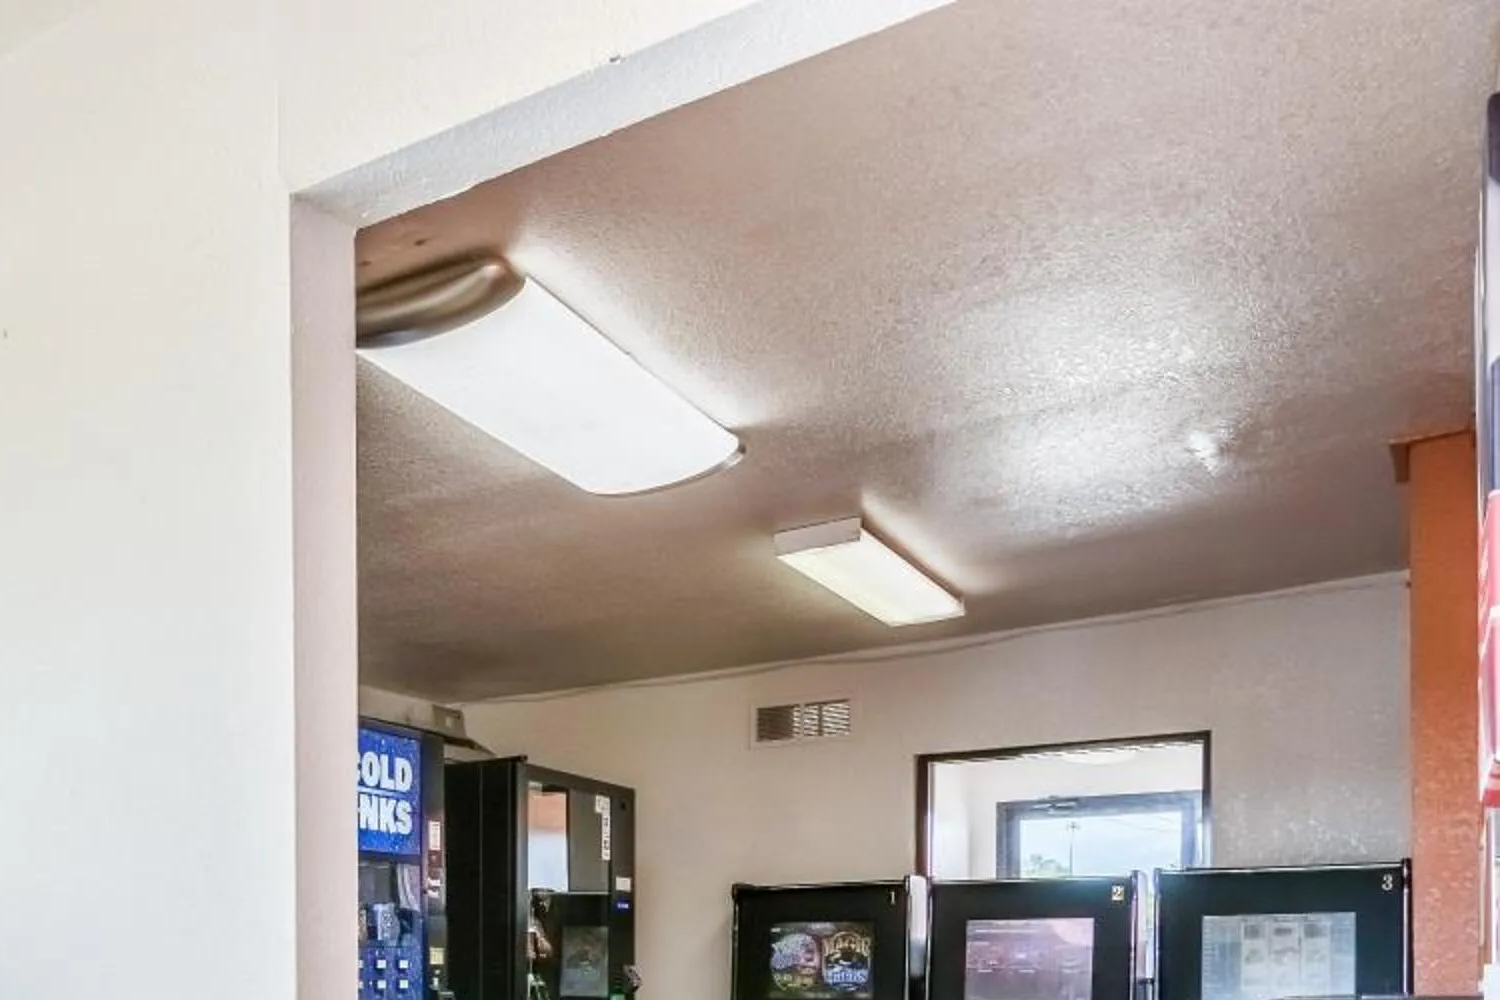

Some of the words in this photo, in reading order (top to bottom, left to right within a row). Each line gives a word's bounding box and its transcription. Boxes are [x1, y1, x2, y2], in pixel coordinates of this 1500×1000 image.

[358, 751, 413, 793] OLD
[358, 794, 413, 835] NKS
[1381, 875, 1393, 891] 3
[890, 890, 897, 905] 1
[1112, 885, 1124, 900] 2
